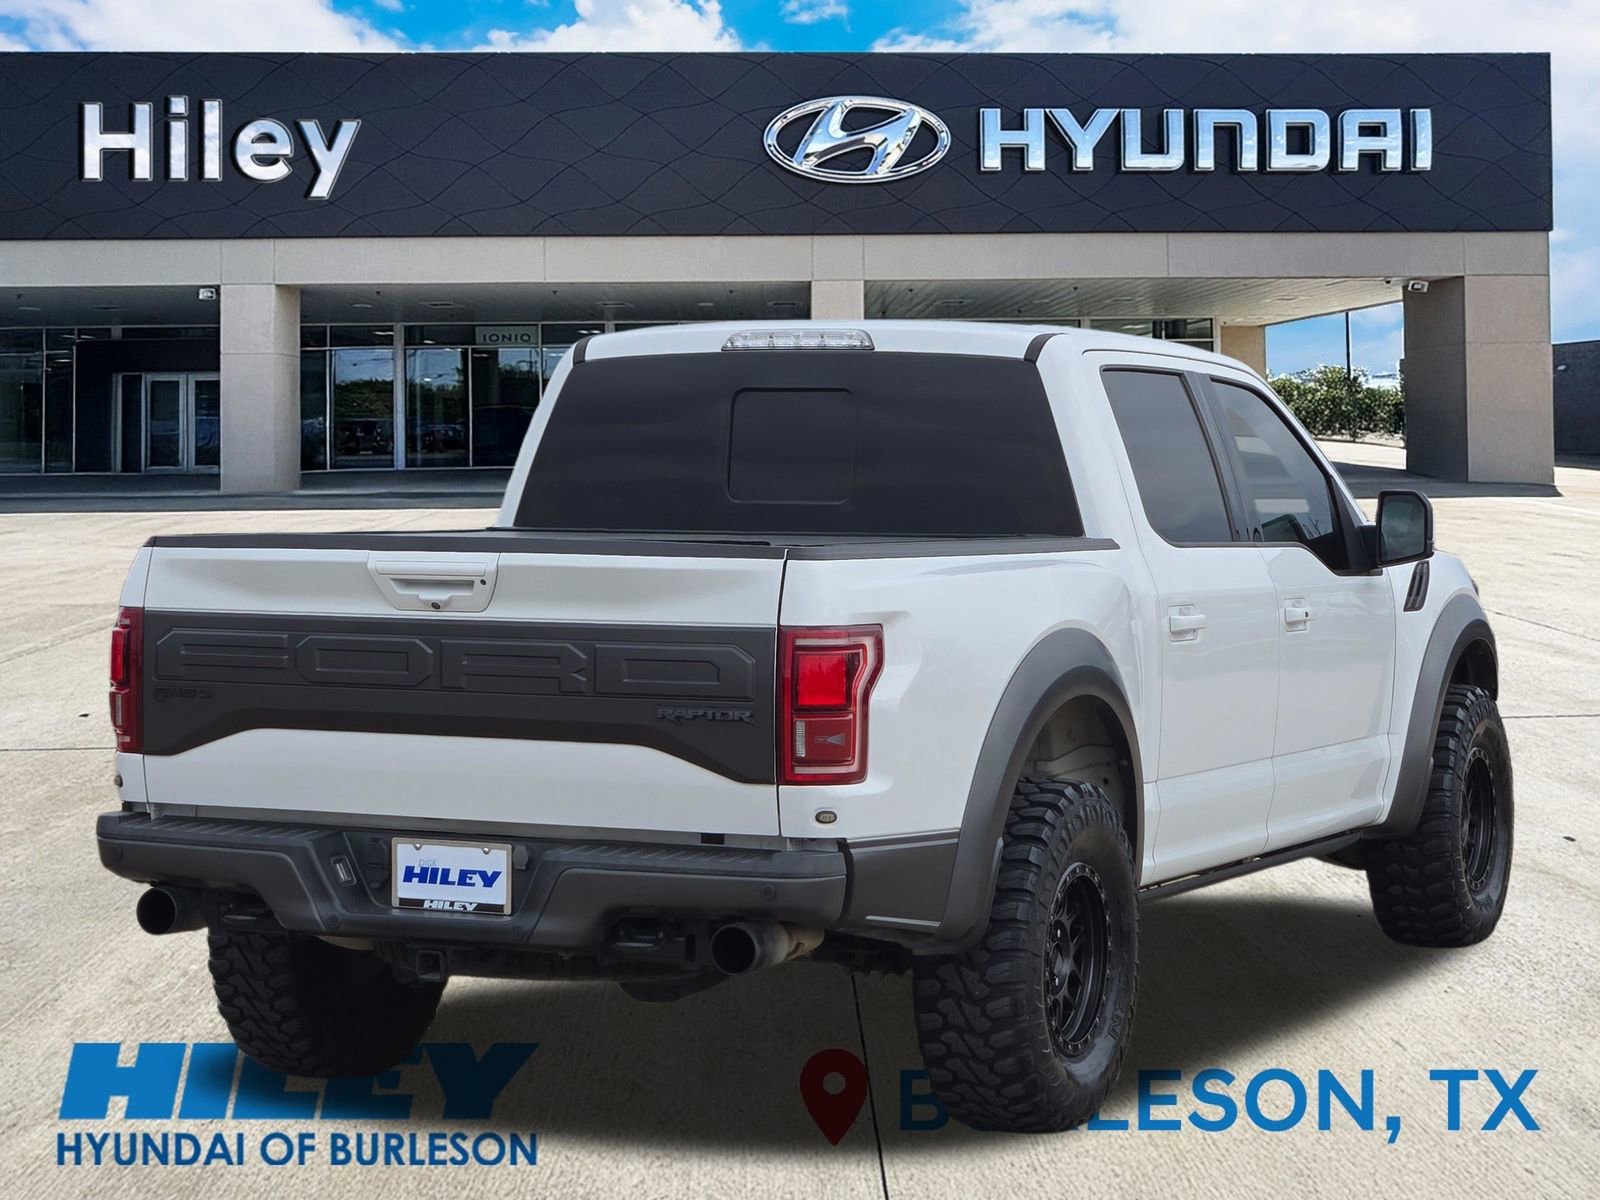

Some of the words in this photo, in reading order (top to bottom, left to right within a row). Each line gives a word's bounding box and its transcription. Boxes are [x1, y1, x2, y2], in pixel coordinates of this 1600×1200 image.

[80, 95, 361, 199] Hiley
[979, 108, 1432, 172] HYUNDAI
[153, 630, 757, 701] FORD
[656, 707, 760, 728] RAPTOR
[403, 865, 502, 888] HILEY
[424, 900, 478, 911] HILEY
